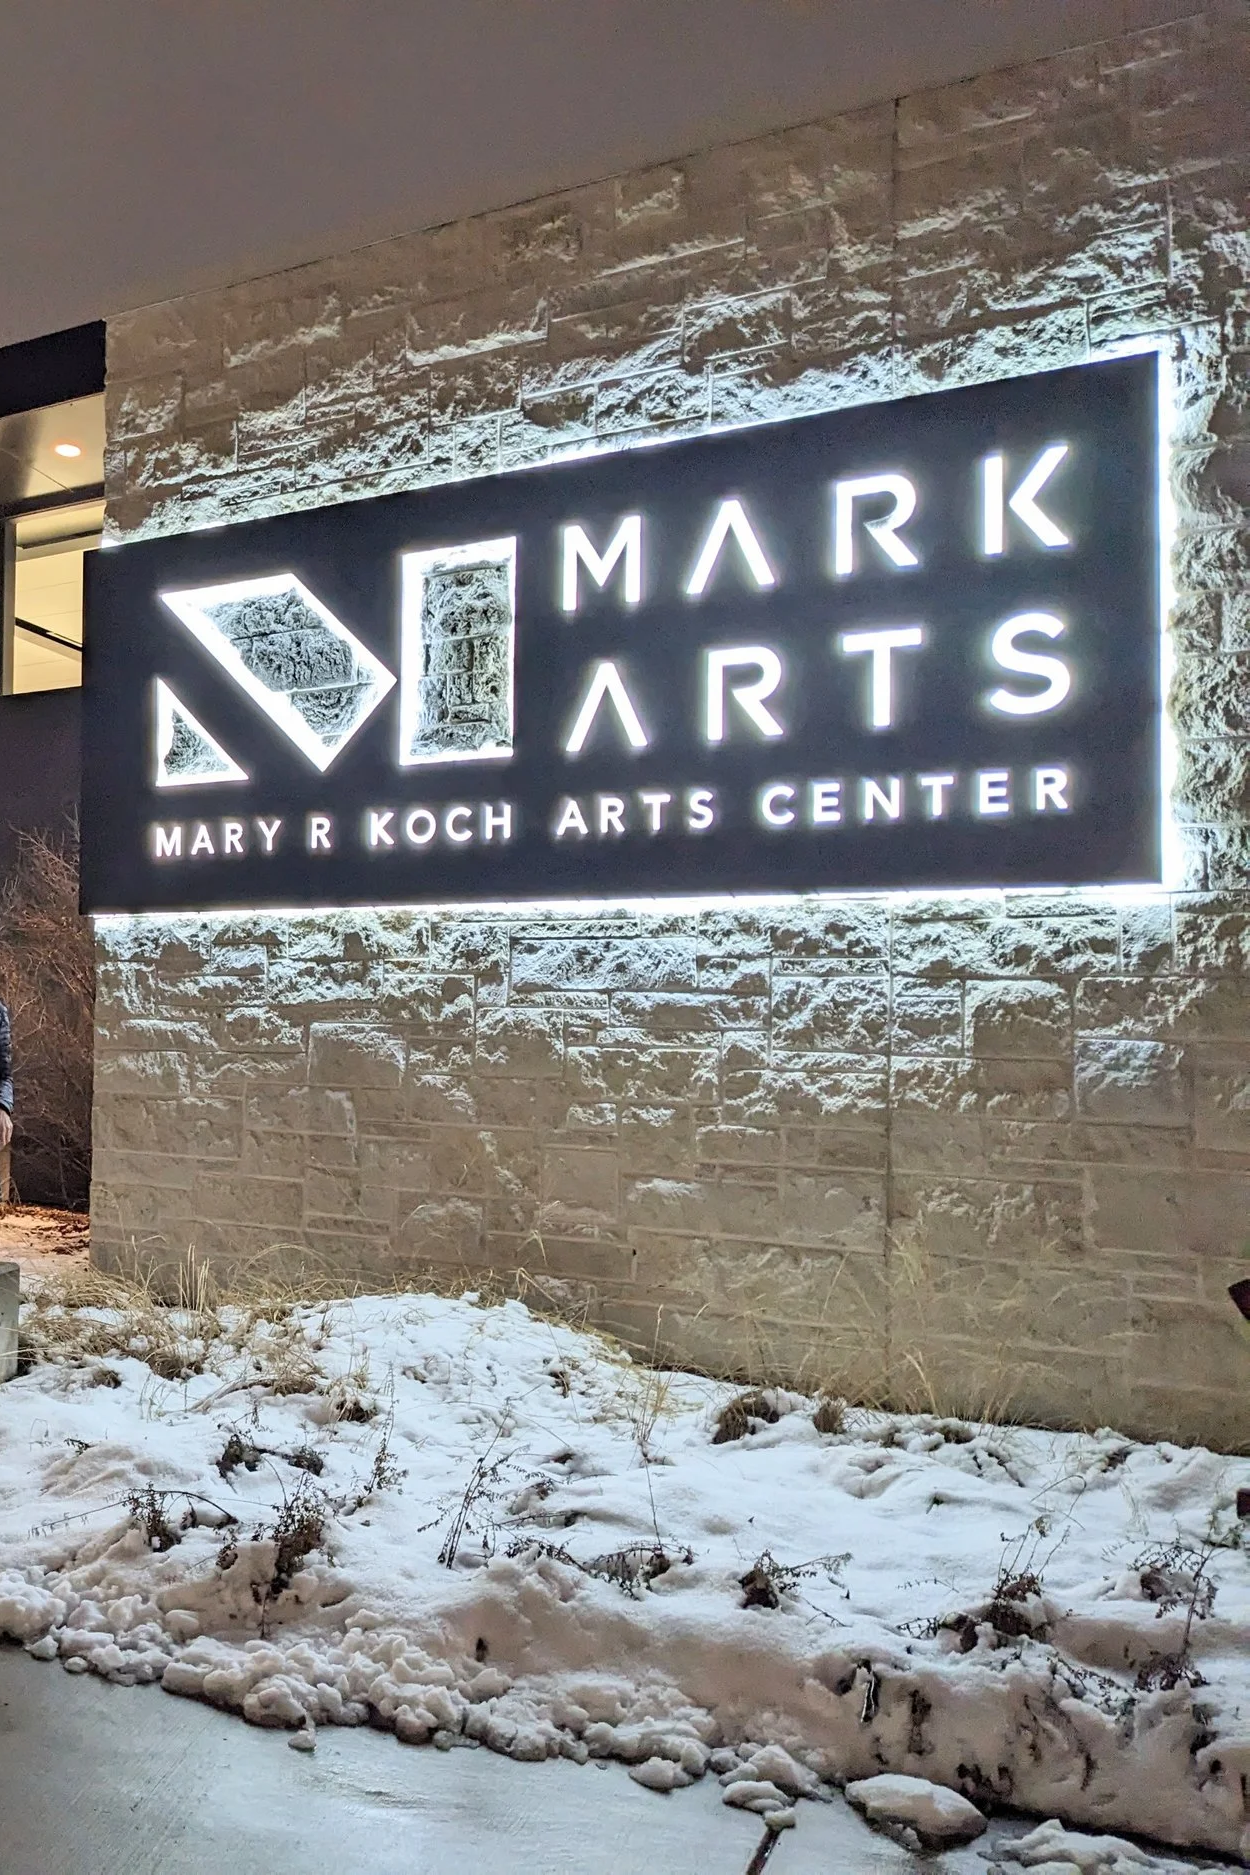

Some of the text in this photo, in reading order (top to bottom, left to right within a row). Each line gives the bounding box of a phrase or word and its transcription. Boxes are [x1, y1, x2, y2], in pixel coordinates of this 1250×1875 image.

[559, 442, 1072, 612] MARK
[565, 610, 1073, 755] ARTS
[153, 767, 1069, 858] MARY R KOCH ARTS CENTER
